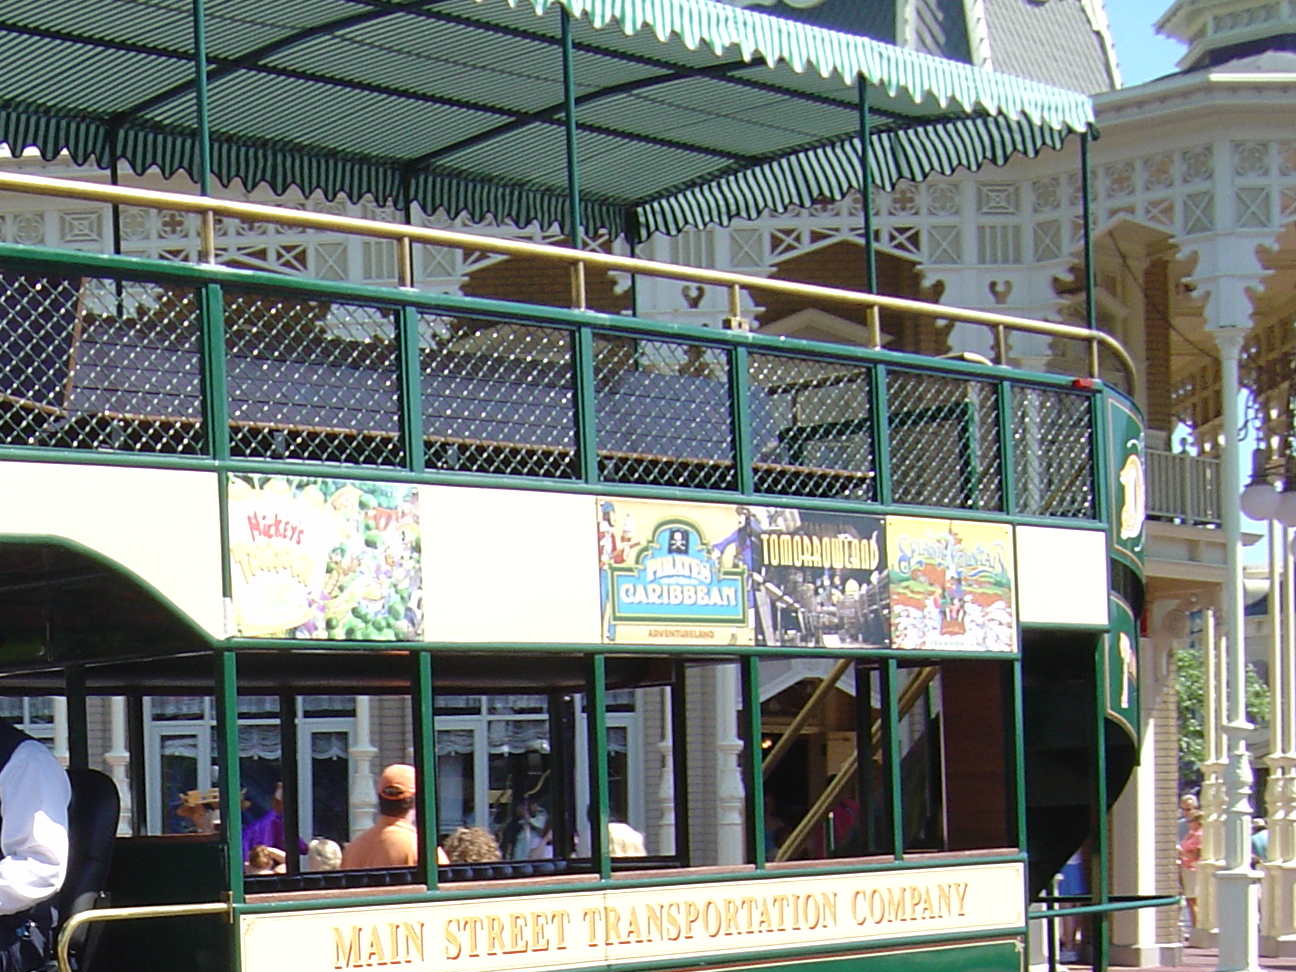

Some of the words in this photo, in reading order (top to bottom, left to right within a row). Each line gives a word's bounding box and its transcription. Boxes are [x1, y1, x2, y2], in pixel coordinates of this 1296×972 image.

[760, 531, 879, 570] TOMORROWLAND
[646, 555, 712, 584] PIRATES
[620, 583, 737, 606] CARIBBEAN
[648, 629, 715, 639] ADVENTURELAND
[331, 920, 425, 969] MAIN
[444, 909, 571, 960] STREET
[582, 892, 837, 947] TRANSPORTATION
[851, 882, 968, 926] COMPANY
